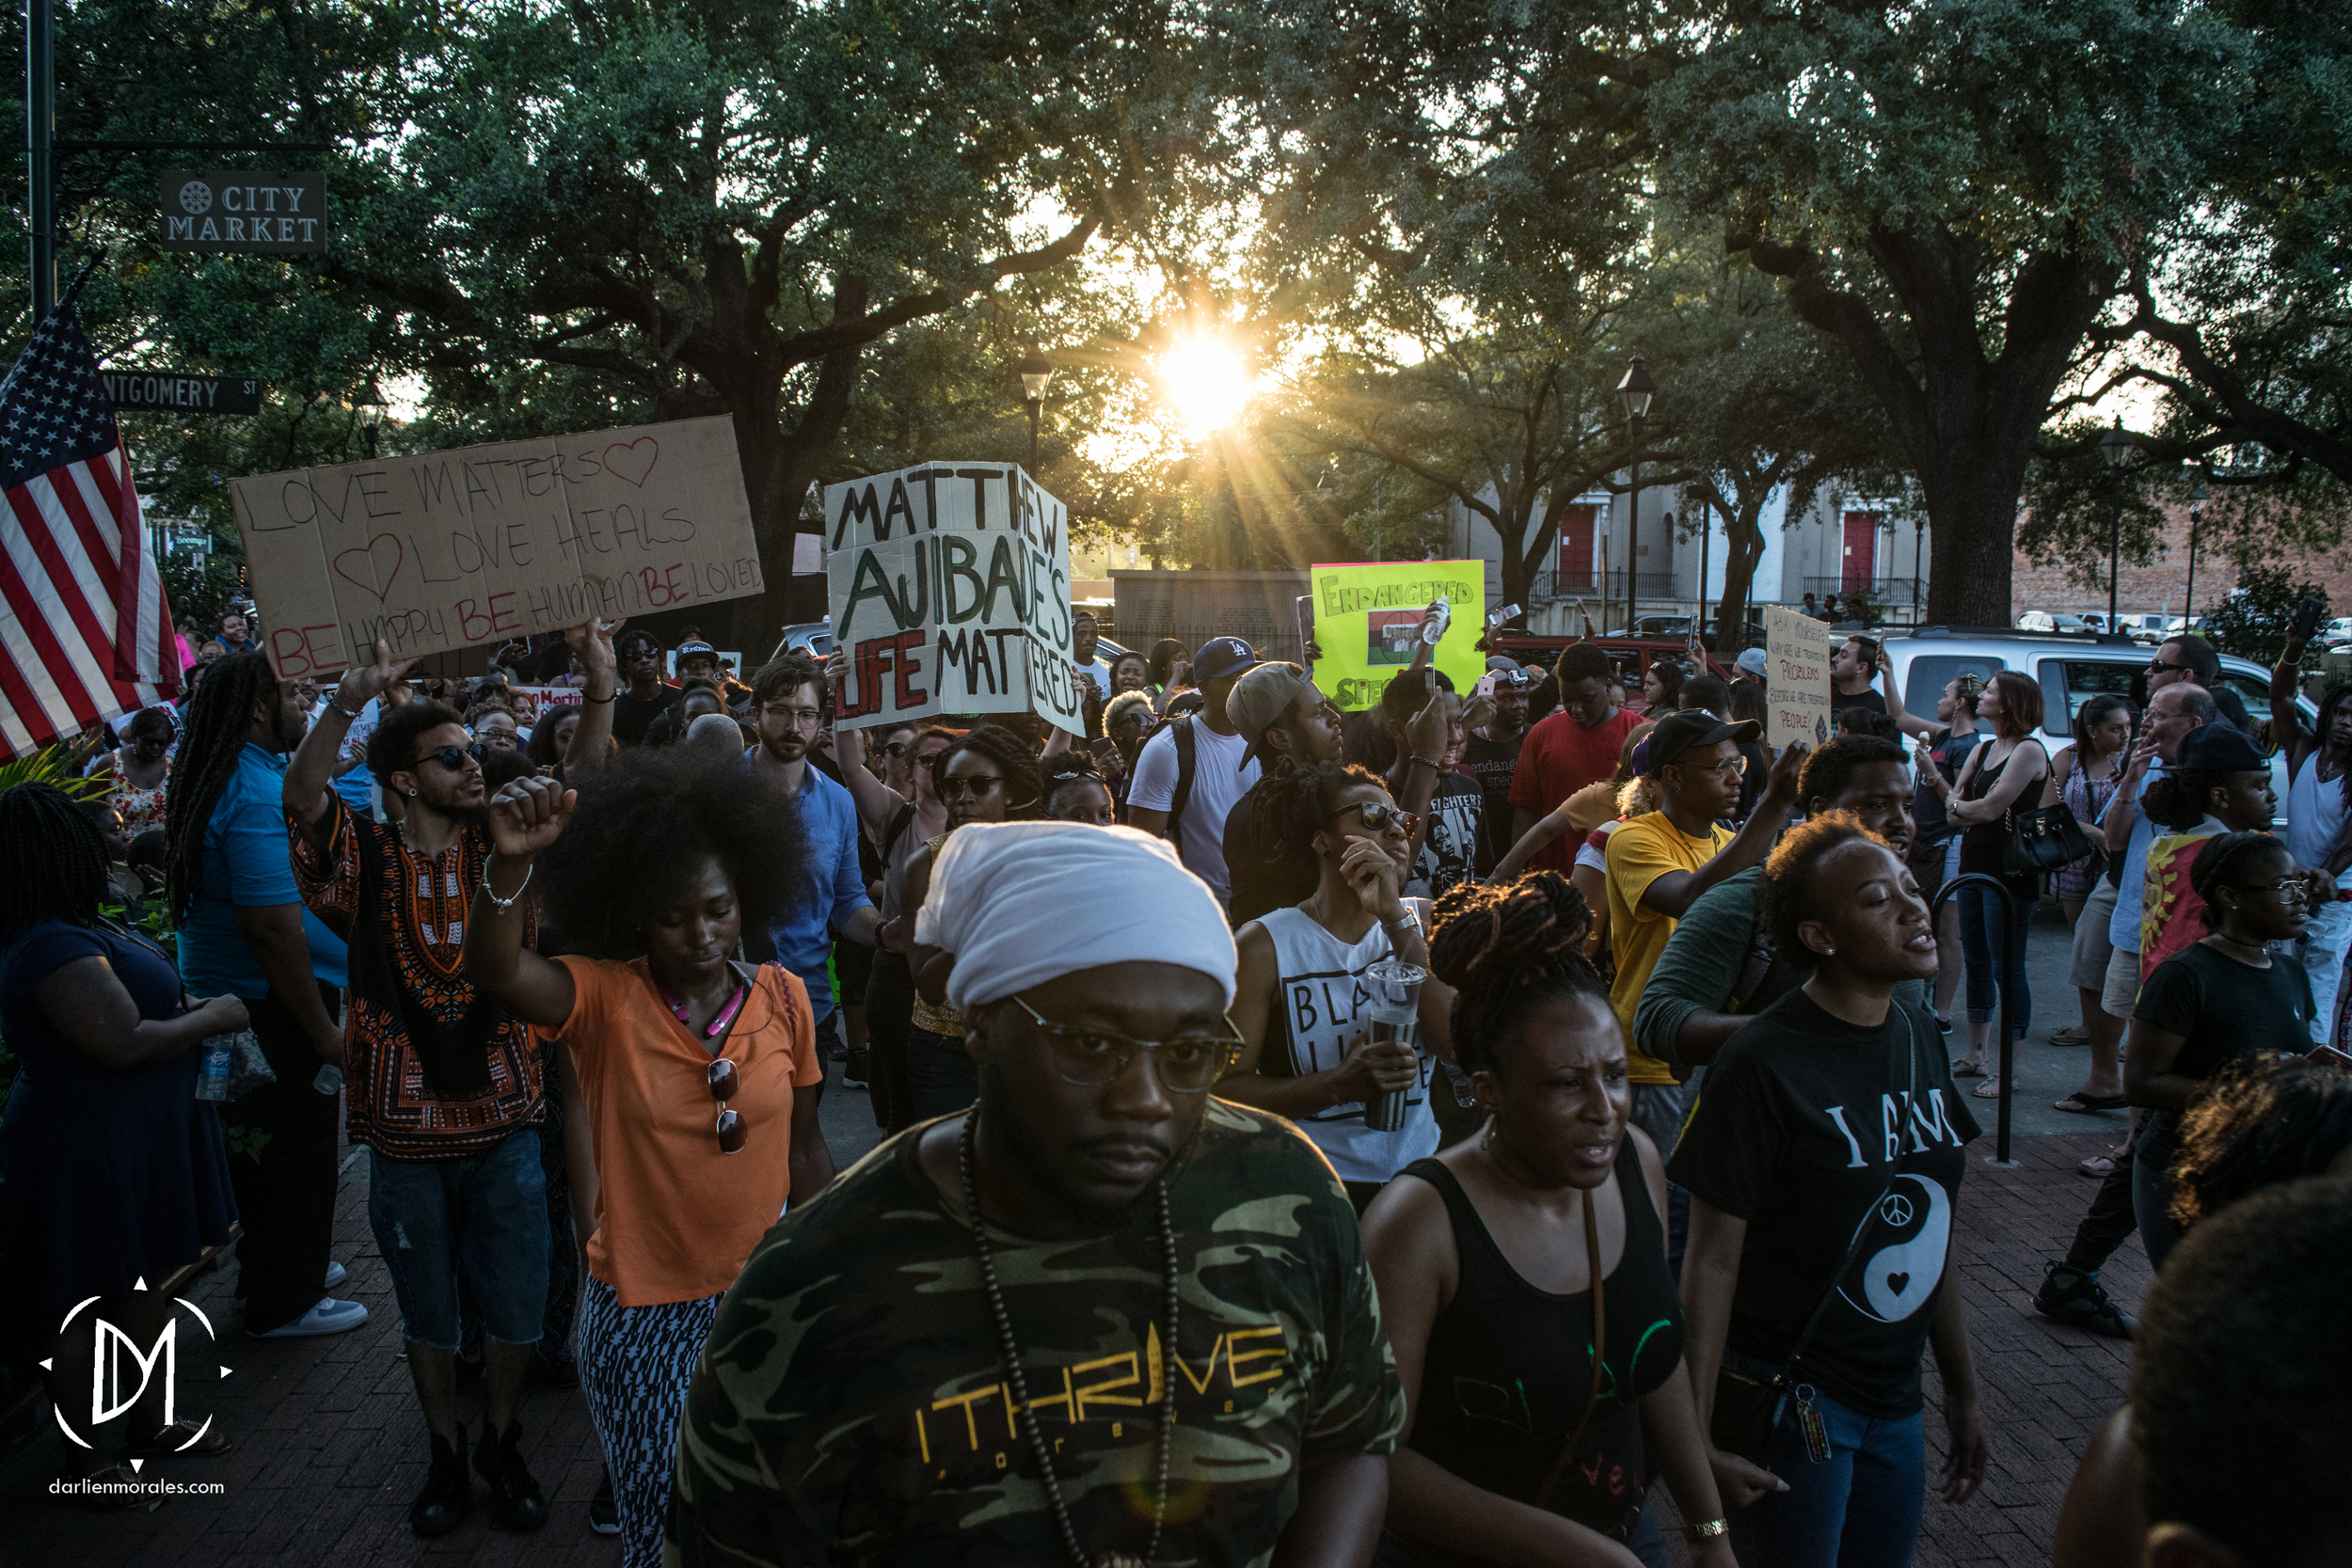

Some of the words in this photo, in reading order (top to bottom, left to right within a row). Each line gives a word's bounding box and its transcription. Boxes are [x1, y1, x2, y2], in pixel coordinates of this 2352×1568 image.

[222, 186, 306, 213] CITY
[167, 215, 319, 243] MARKET
[244, 380, 258, 395] ST
[236, 471, 402, 531] LOVE
[411, 450, 602, 517] MATTERS
[832, 468, 1058, 560] MATTHEW
[408, 523, 533, 583] LOVE
[552, 503, 696, 561] HEALS
[836, 533, 1071, 652] AJIBADE'S
[1319, 575, 1475, 618] ENDANGERED
[270, 623, 351, 678] BE
[348, 608, 450, 664] HAPPY
[453, 591, 523, 641] BE
[527, 570, 642, 626] HUMAN
[638, 562, 690, 608] BE
[691, 557, 762, 598] LOVED
[1228, 641, 1248, 657] LA
[834, 628, 929, 721] LIFE
[934, 626, 1079, 718] MATTERED
[1780, 659, 1820, 681] PROBLEMS
[1779, 709, 1812, 734] PEOPLE?
[1470, 759, 1518, 773] endang
[1430, 793, 1483, 811] FIGHTERS
[1824, 1105, 1869, 1168] I
[1882, 1088, 1964, 1162] AM
